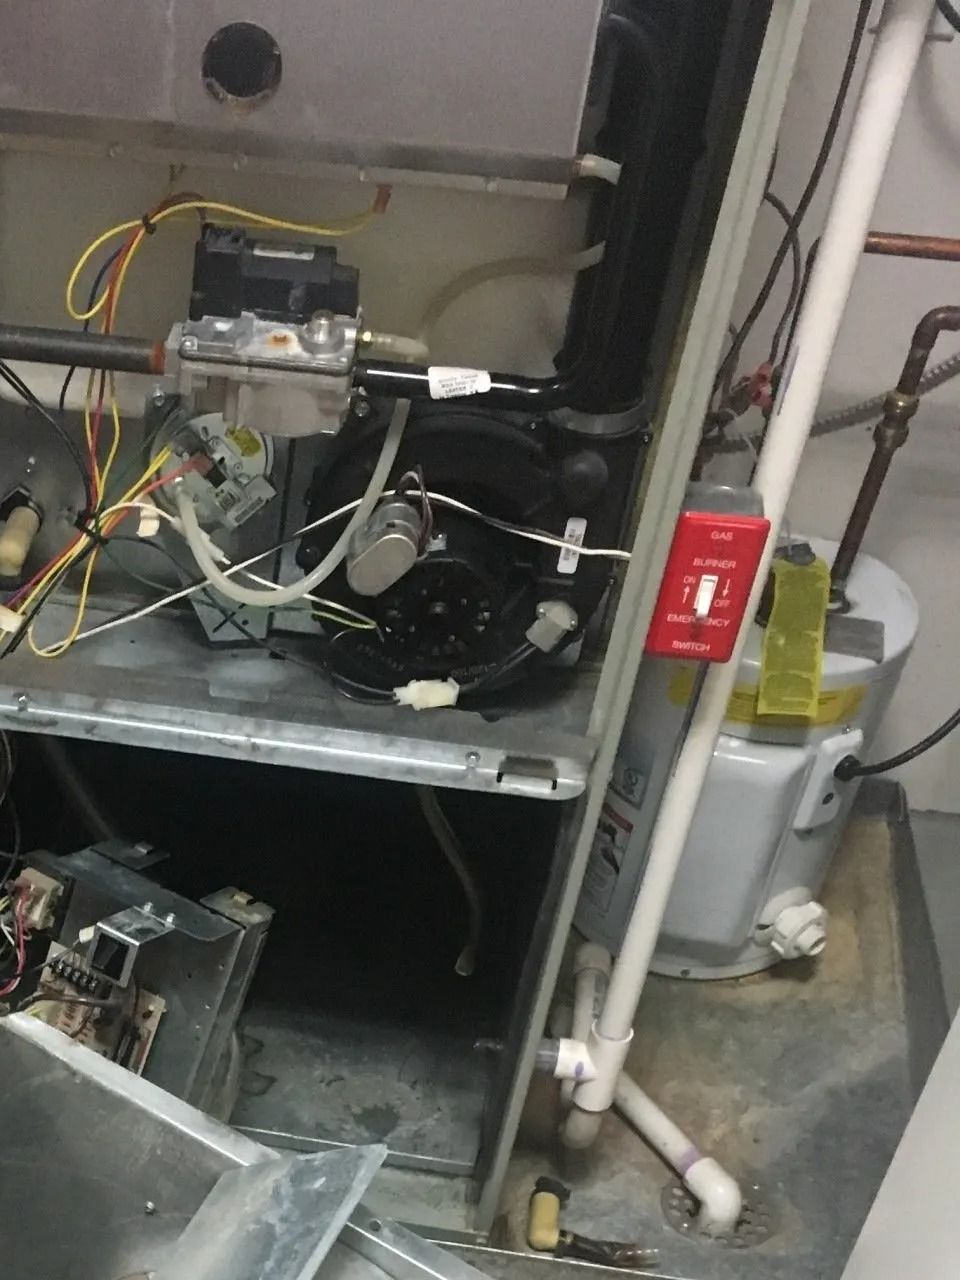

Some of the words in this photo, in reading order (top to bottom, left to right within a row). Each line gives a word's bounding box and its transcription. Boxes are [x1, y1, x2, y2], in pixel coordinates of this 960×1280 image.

[711, 530, 733, 541] GAS
[693, 557, 736, 569] BURNER
[683, 575, 696, 584] ON
[713, 599, 730, 608] OFF
[666, 613, 730, 627] EMERENCY
[671, 639, 710, 651] SWITCH
